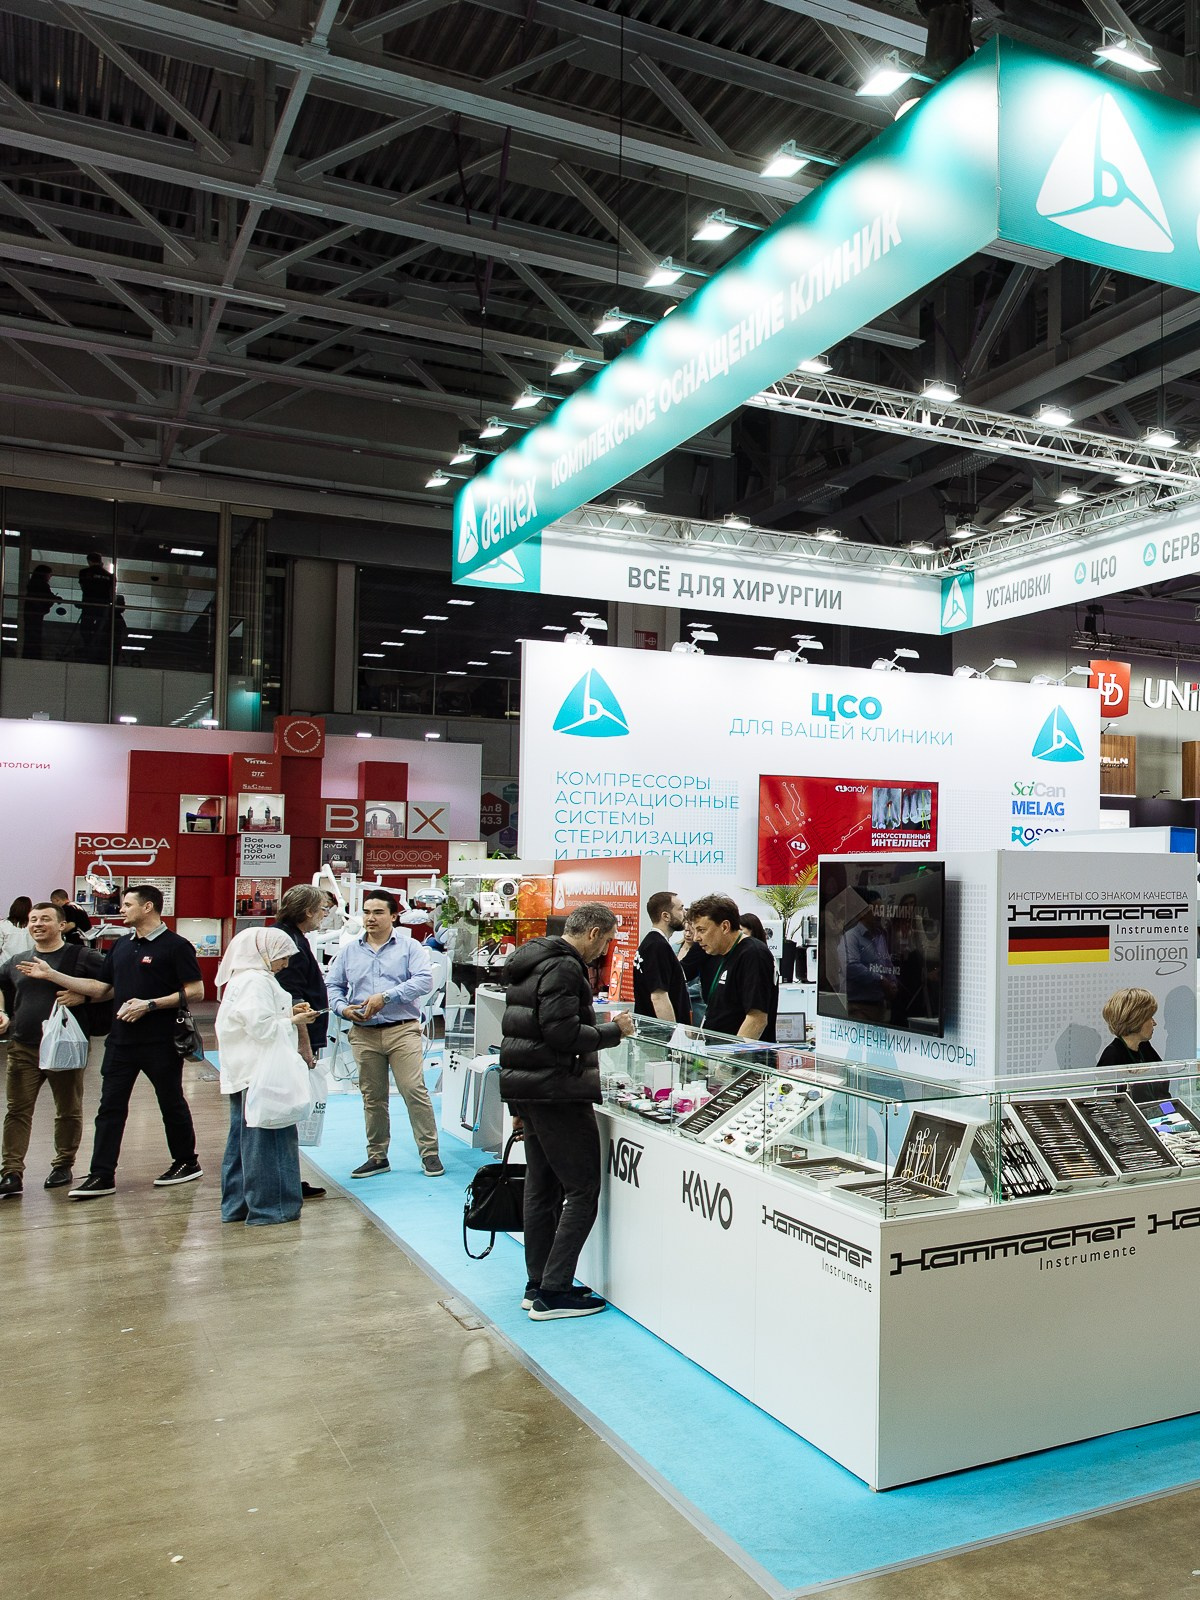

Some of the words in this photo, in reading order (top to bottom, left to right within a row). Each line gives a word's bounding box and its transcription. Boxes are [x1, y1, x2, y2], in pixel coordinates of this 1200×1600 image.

[551, 391, 656, 490] КОМПЛЕКСНОЕ
[659, 292, 785, 413] ОСНАЩЕНИЕ
[790, 203, 903, 321] КЛИНИК
[481, 474, 538, 551] dentex
[1090, 555, 1117, 586] ЦСО
[627, 565, 671, 592] ВСЁ
[677, 572, 726, 598] ДЛЯ
[732, 578, 843, 611] ХИРУРГИИ
[986, 572, 1052, 609] УСТАНОВКИ
[811, 692, 883, 722] ЦСО
[729, 718, 773, 737] ДЛЯ
[781, 722, 854, 741] ВАШЕЙ
[861, 725, 953, 746] КЛИНИКИ
[556, 771, 711, 790] КОМПРЕССОРЫ
[1011, 781, 1067, 798] SciCan
[554, 790, 740, 810] АСПИРАЦИОННЫЕ
[1011, 800, 1066, 817] MELAG
[554, 809, 655, 826] СИСТЕМЫ
[78, 836, 171, 849] ROCADA
[554, 829, 714, 847] СТЕРИЛИЗАЦИЯ
[871, 832, 931, 840] ИСКУССТВЕННЫЙ
[871, 839, 931, 848] ИНТЕЛЛЕКТ
[1011, 826, 1066, 847] ROS
[243, 852, 276, 861] рукой!
[555, 848, 568, 860] И
[601, 881, 638, 896] ПРАКТИКА
[1008, 891, 1083, 901] ИНСТРУМЕНТЫ
[1085, 891, 1099, 900] СО
[1101, 891, 1141, 900] ЗНАКОМ
[1143, 891, 1188, 900] КАЧЕСТВА
[1007, 903, 1189, 921] Hammacher
[1116, 924, 1189, 934] Instrumente
[1114, 945, 1189, 974] Solingen
[830, 1023, 911, 1055] НАКОНЕЧНИКИ
[920, 1038, 976, 1068] МОТОРЫ
[607, 1137, 645, 1188] NSK
[761, 1204, 873, 1269] Hammacher
[889, 1216, 1136, 1277] Hammacher
[1039, 1243, 1137, 1271] Instrumente
[821, 1257, 873, 1293] Instrumente
